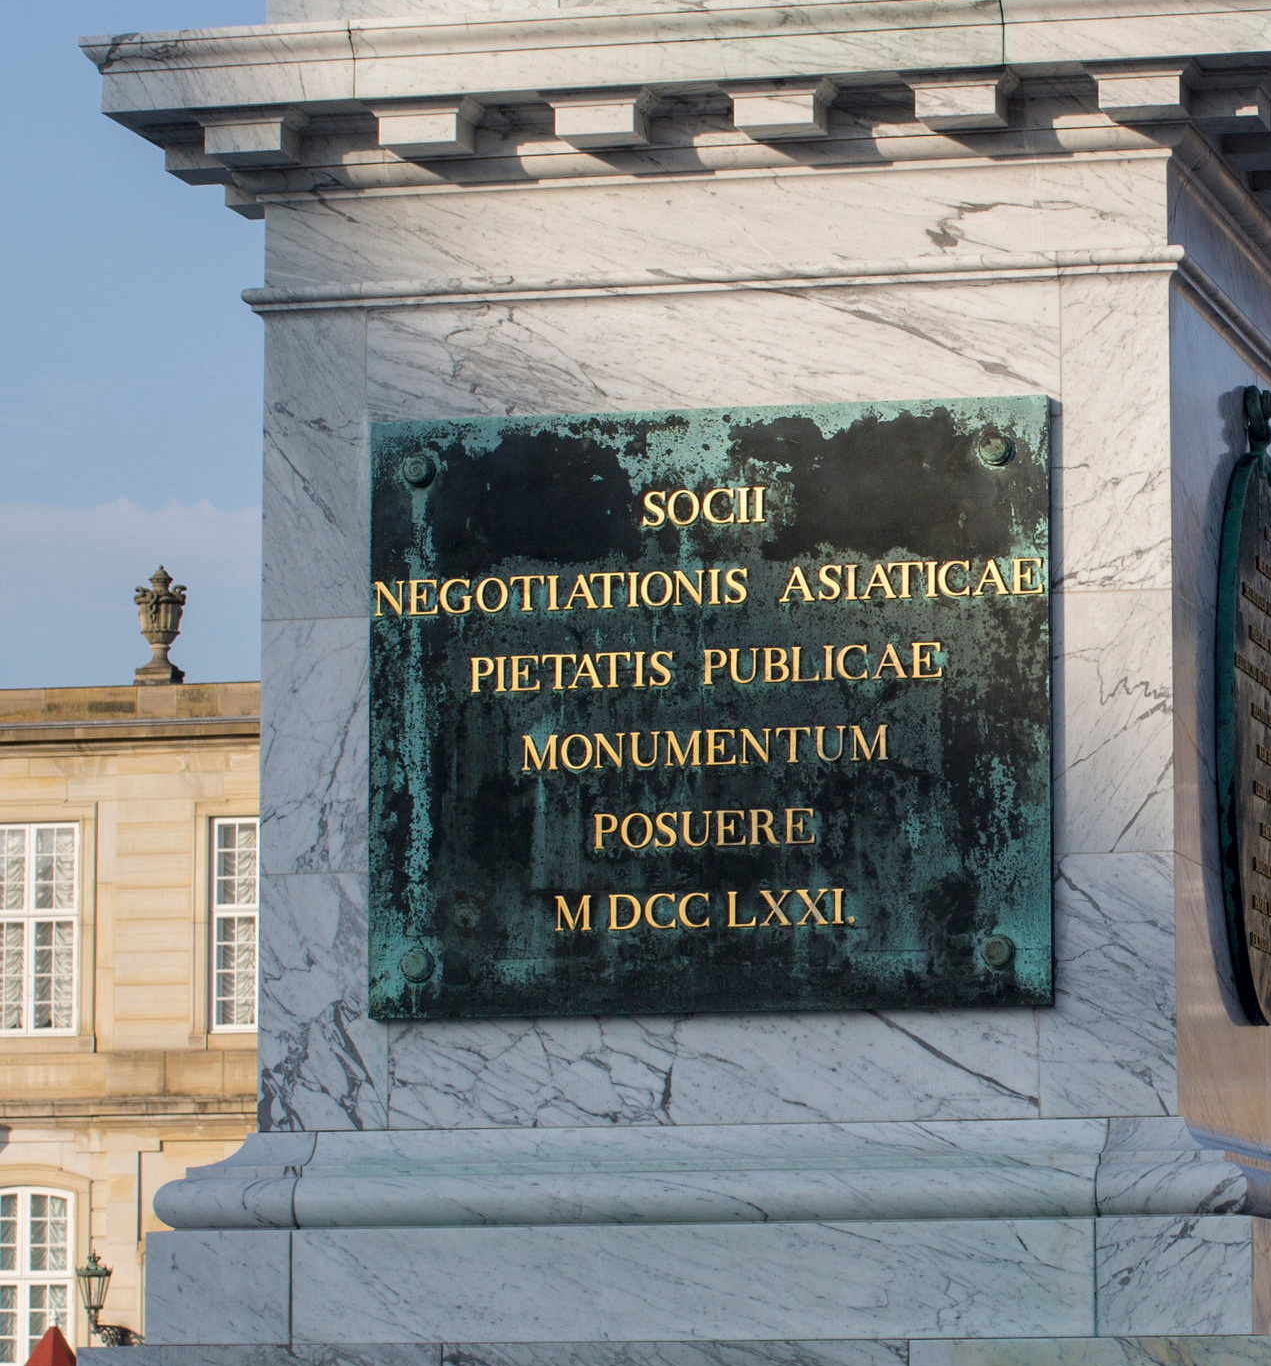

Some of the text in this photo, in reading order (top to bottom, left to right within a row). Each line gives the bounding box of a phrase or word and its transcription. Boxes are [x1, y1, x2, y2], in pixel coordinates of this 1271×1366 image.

[641, 486, 766, 528] SOCII
[374, 557, 1045, 617] NEGOTIATIONIS ASIATICAE
[469, 641, 944, 693] PIETATIS PUBLICAE
[521, 724, 890, 772] MONUMENTUM
[593, 807, 816, 850] POSUERE
